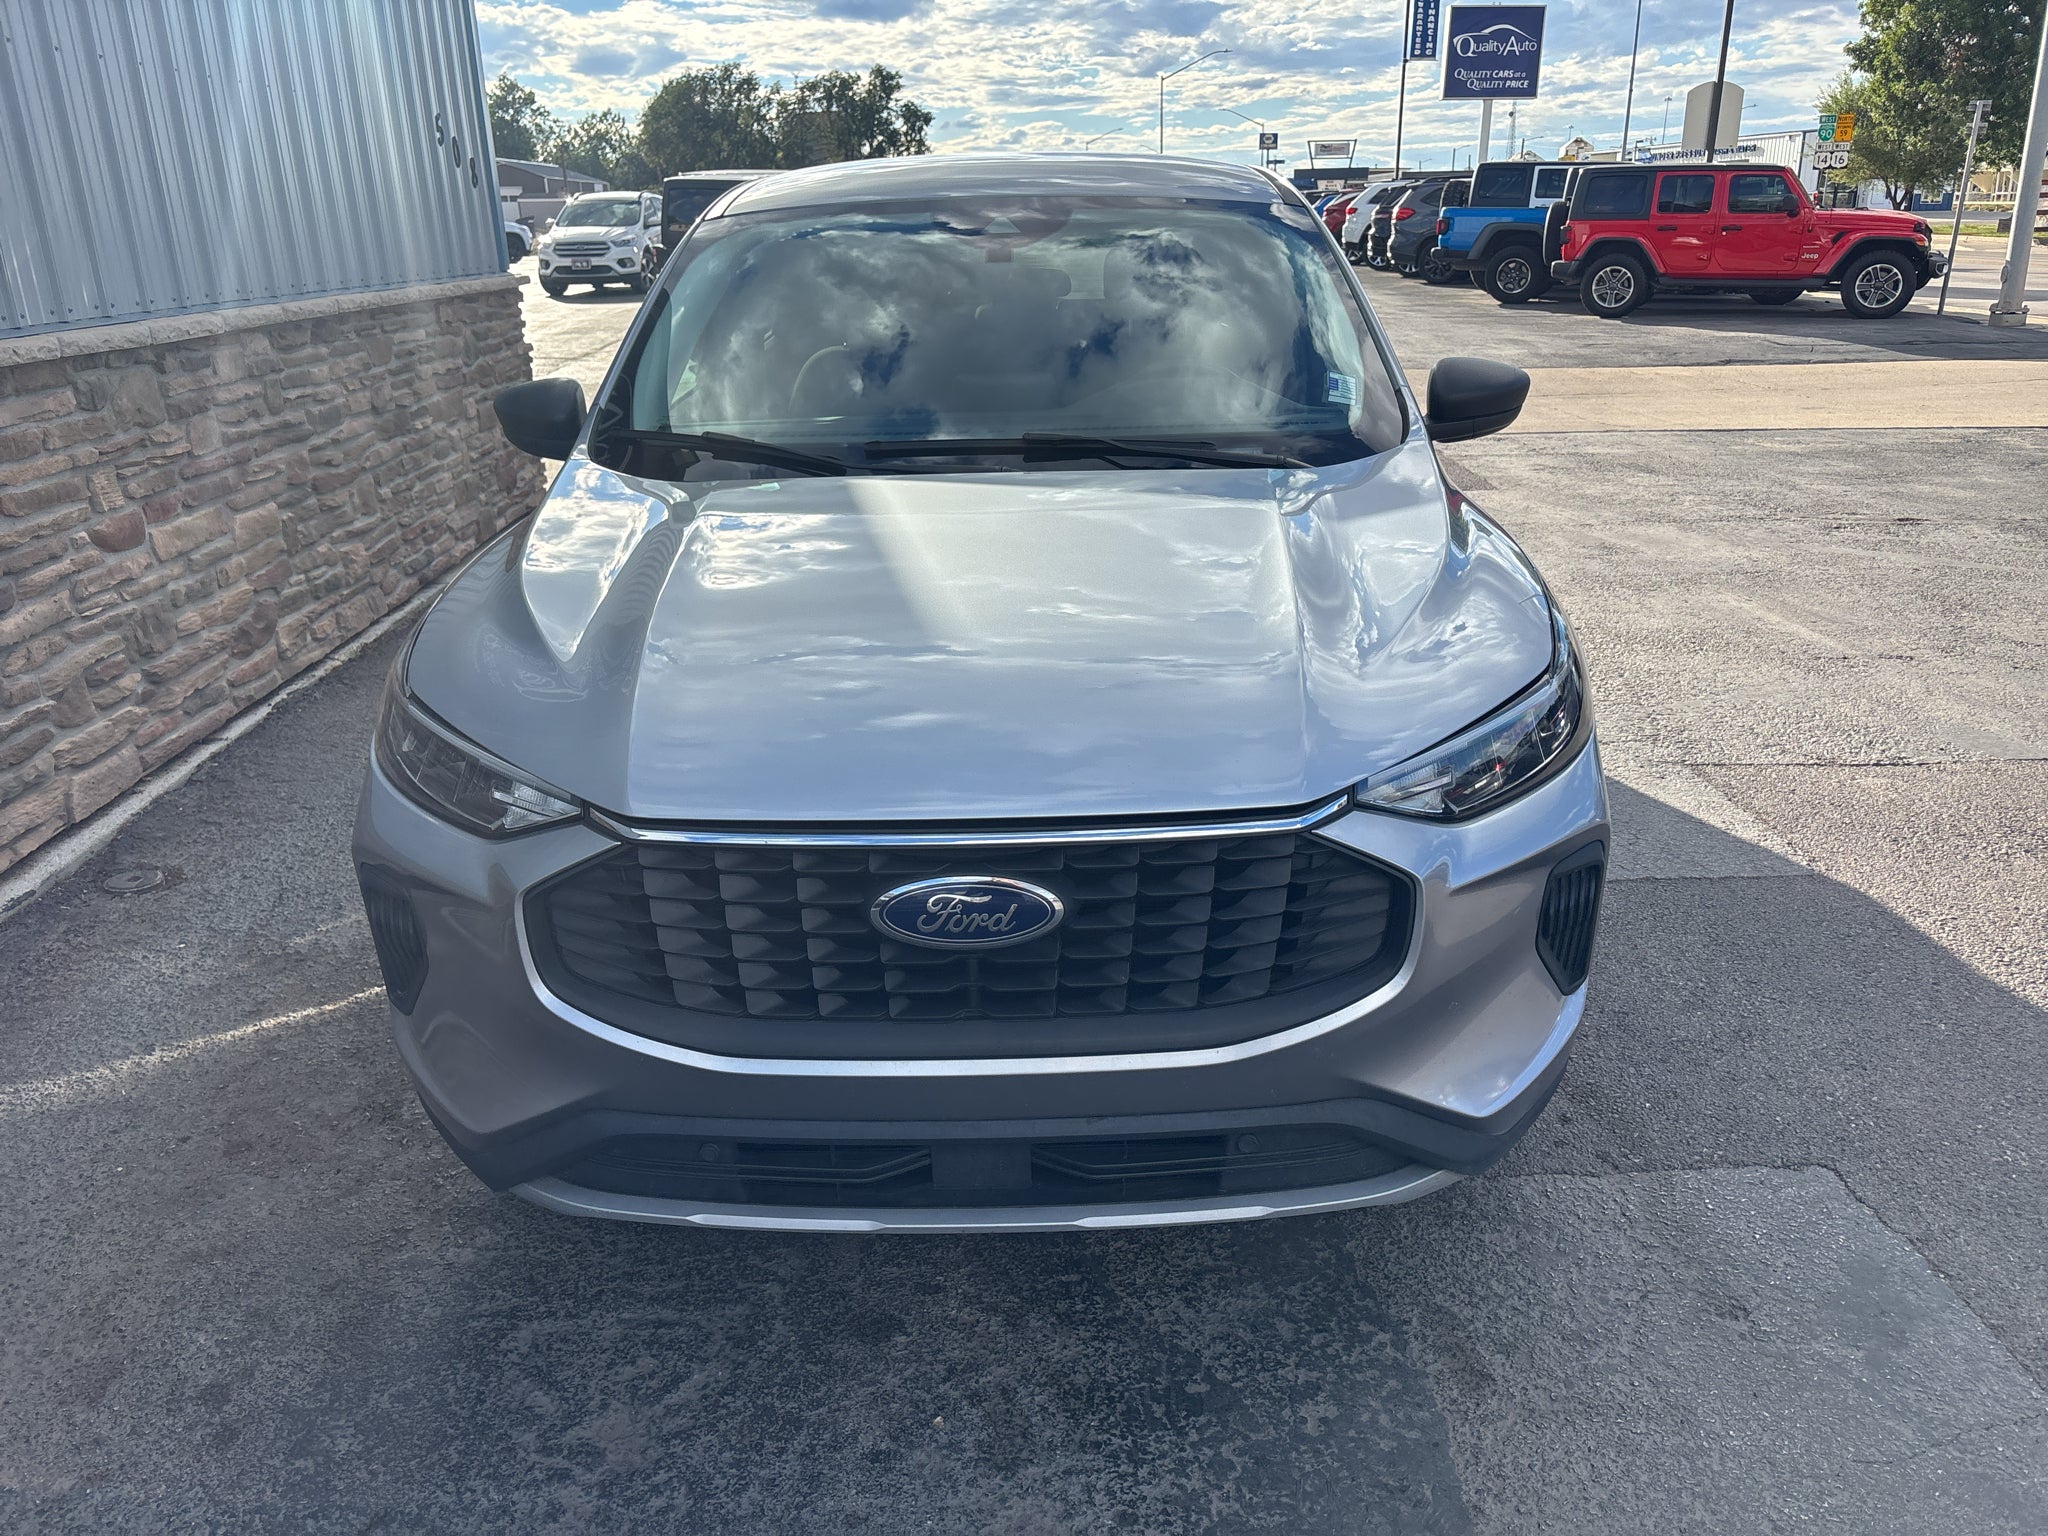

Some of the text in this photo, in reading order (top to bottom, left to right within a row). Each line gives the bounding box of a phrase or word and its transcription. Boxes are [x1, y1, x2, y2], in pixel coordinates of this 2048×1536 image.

[1414, 0, 1424, 55] UARANTEED
[1425, 0, 1436, 55] INANCING
[1492, 70, 1514, 78] CARS
[1505, 80, 1529, 88] PRICE
[1820, 129, 1832, 138] 90
[435, 113, 478, 188] 508
[1817, 155, 1828, 165] 14
[1834, 155, 1845, 165] 16
[916, 893, 1018, 933] Ford
